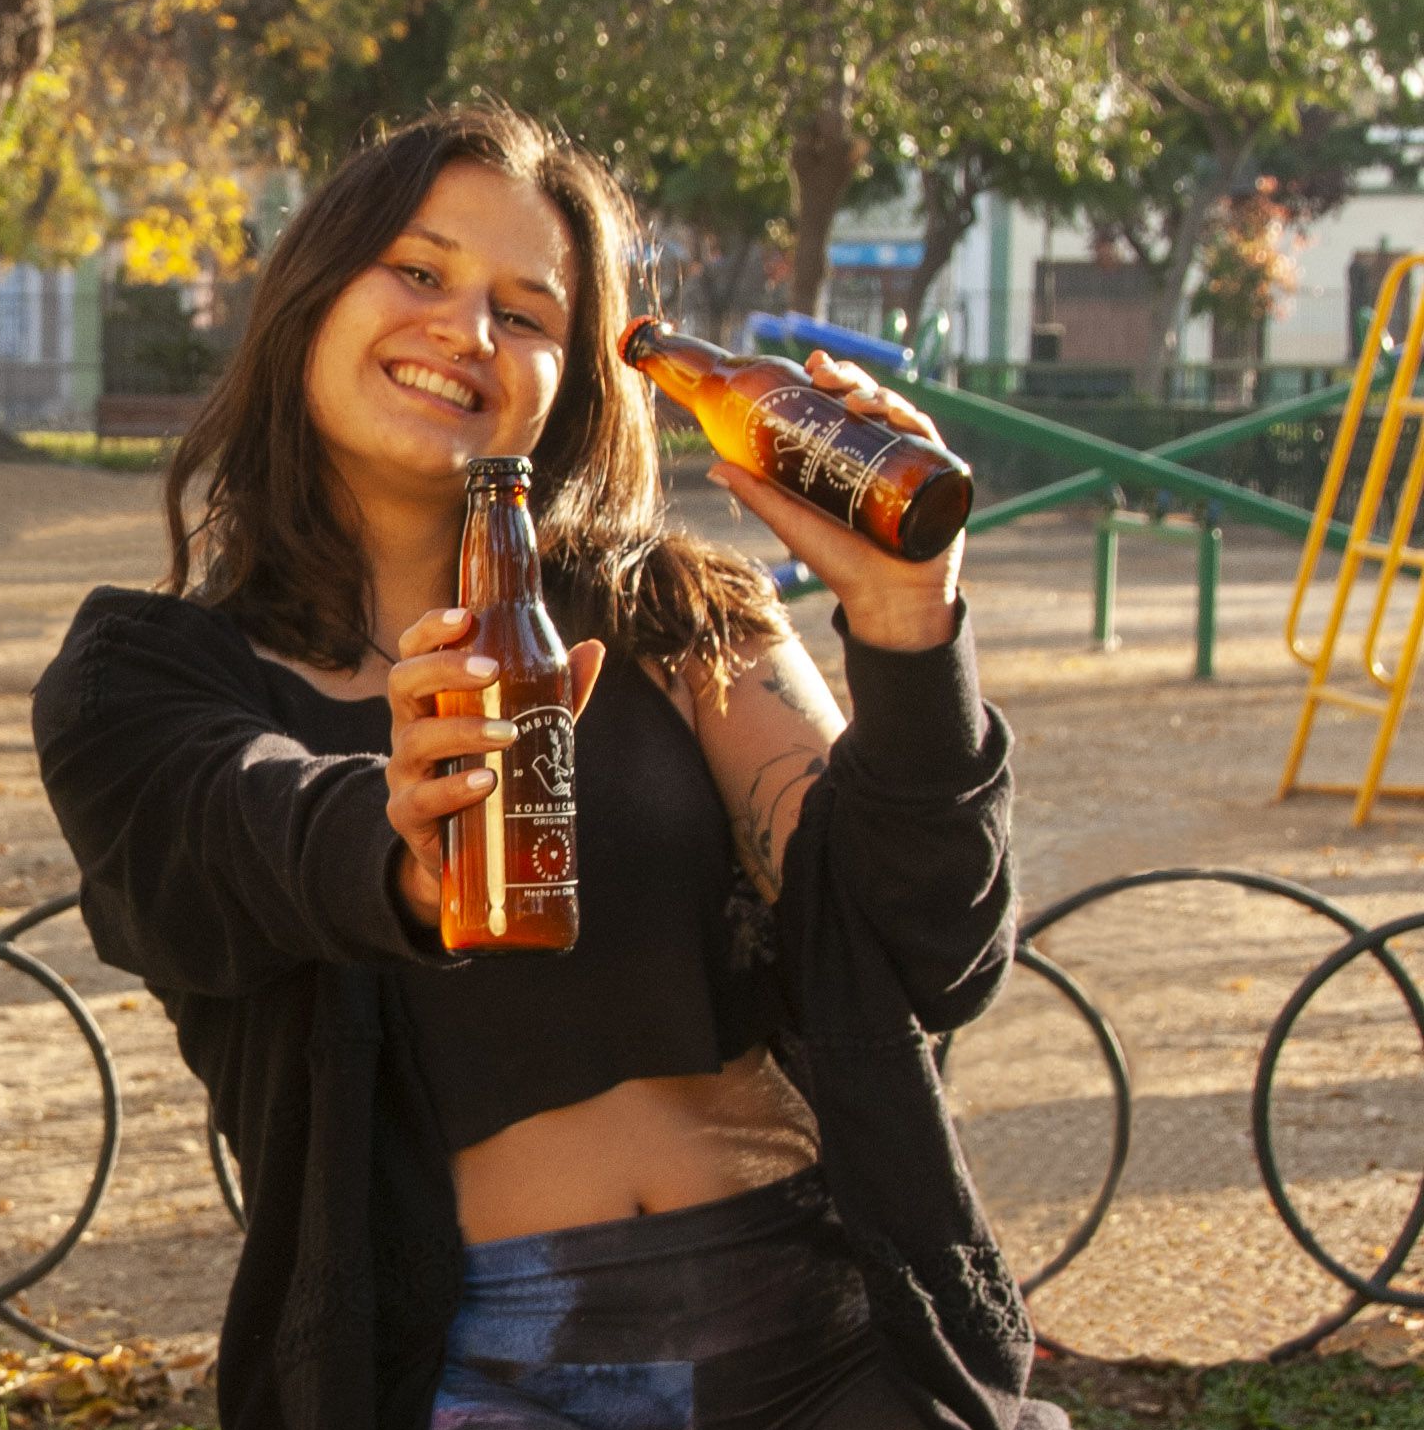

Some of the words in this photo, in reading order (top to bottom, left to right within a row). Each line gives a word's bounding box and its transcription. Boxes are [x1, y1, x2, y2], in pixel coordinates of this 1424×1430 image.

[513, 769, 524, 778] 20
[514, 800, 576, 813] KOMBUCHA
[523, 887, 551, 898] Hecho
